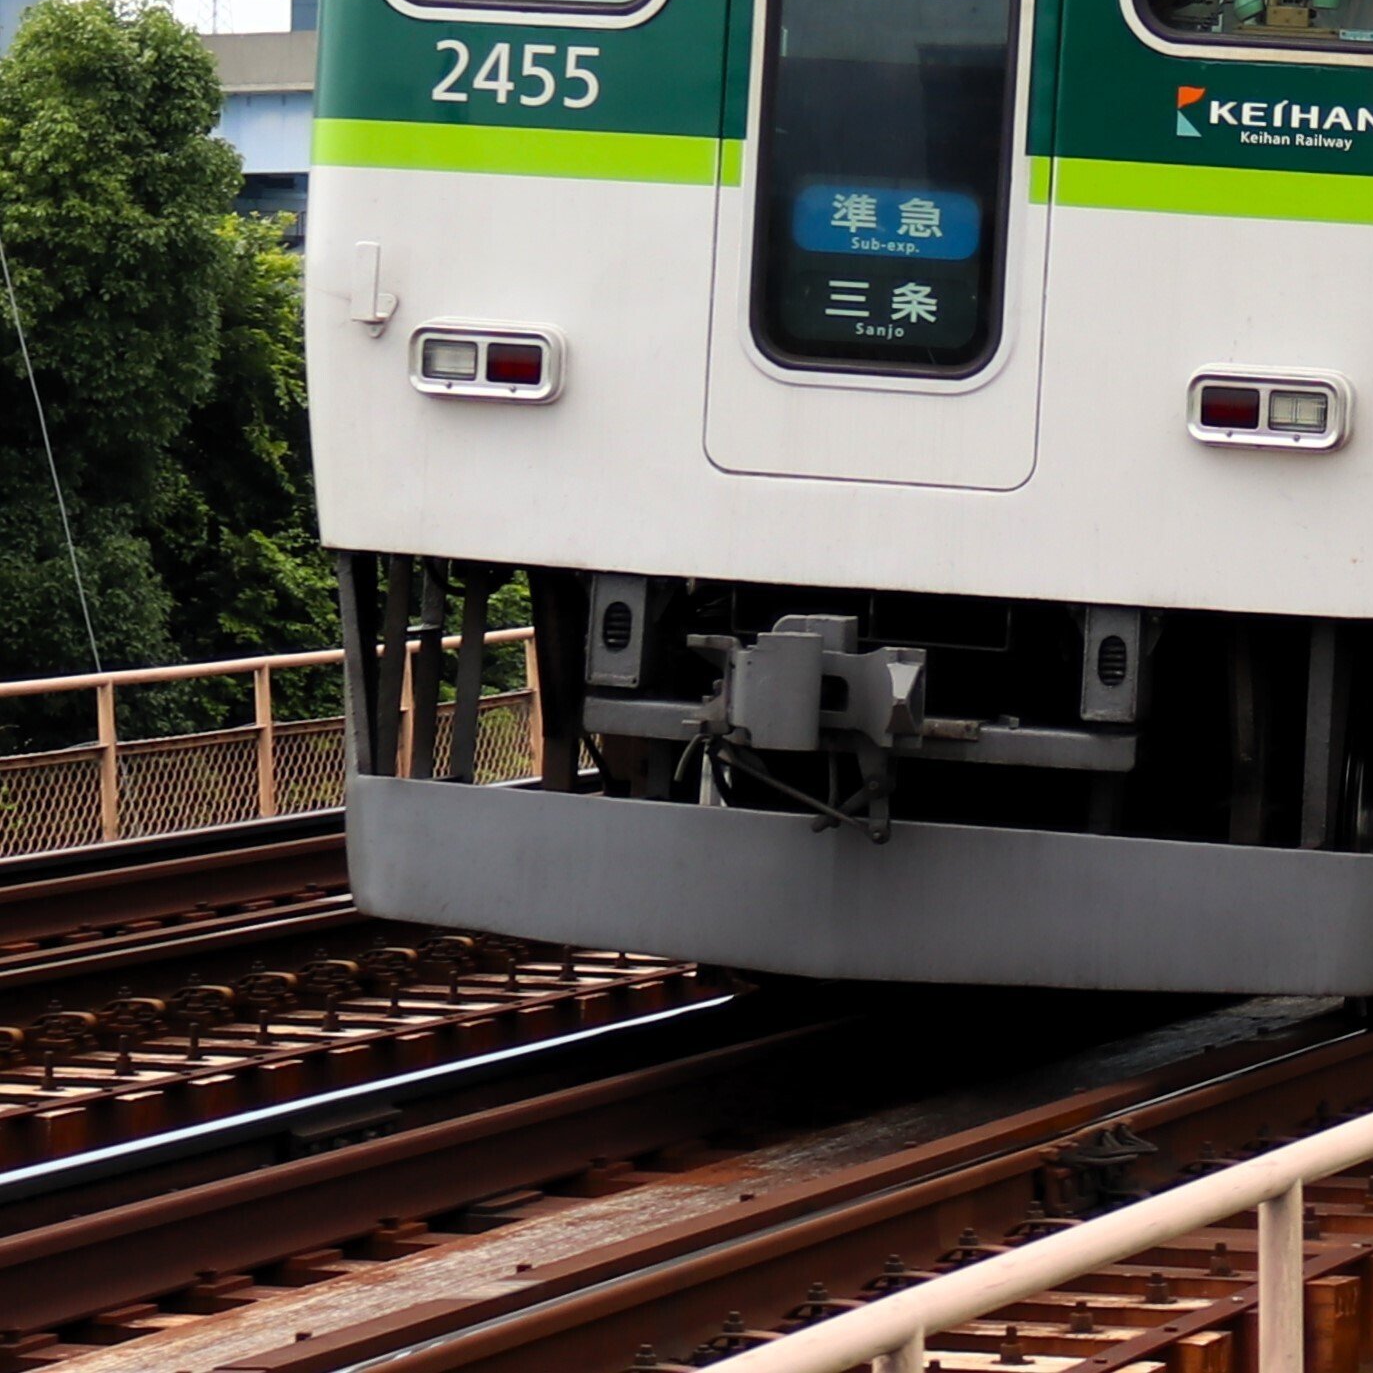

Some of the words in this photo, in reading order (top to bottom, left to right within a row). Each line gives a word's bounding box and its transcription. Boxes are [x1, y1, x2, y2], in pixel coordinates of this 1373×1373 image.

[431, 39, 600, 109] 2455
[1240, 130, 1291, 146] Keihan
[1295, 133, 1353, 152] Railway
[831, 193, 943, 238] 準急
[851, 236, 921, 255] Sub-exp.
[825, 280, 938, 323] 三条
[855, 322, 905, 340] Sanjo
